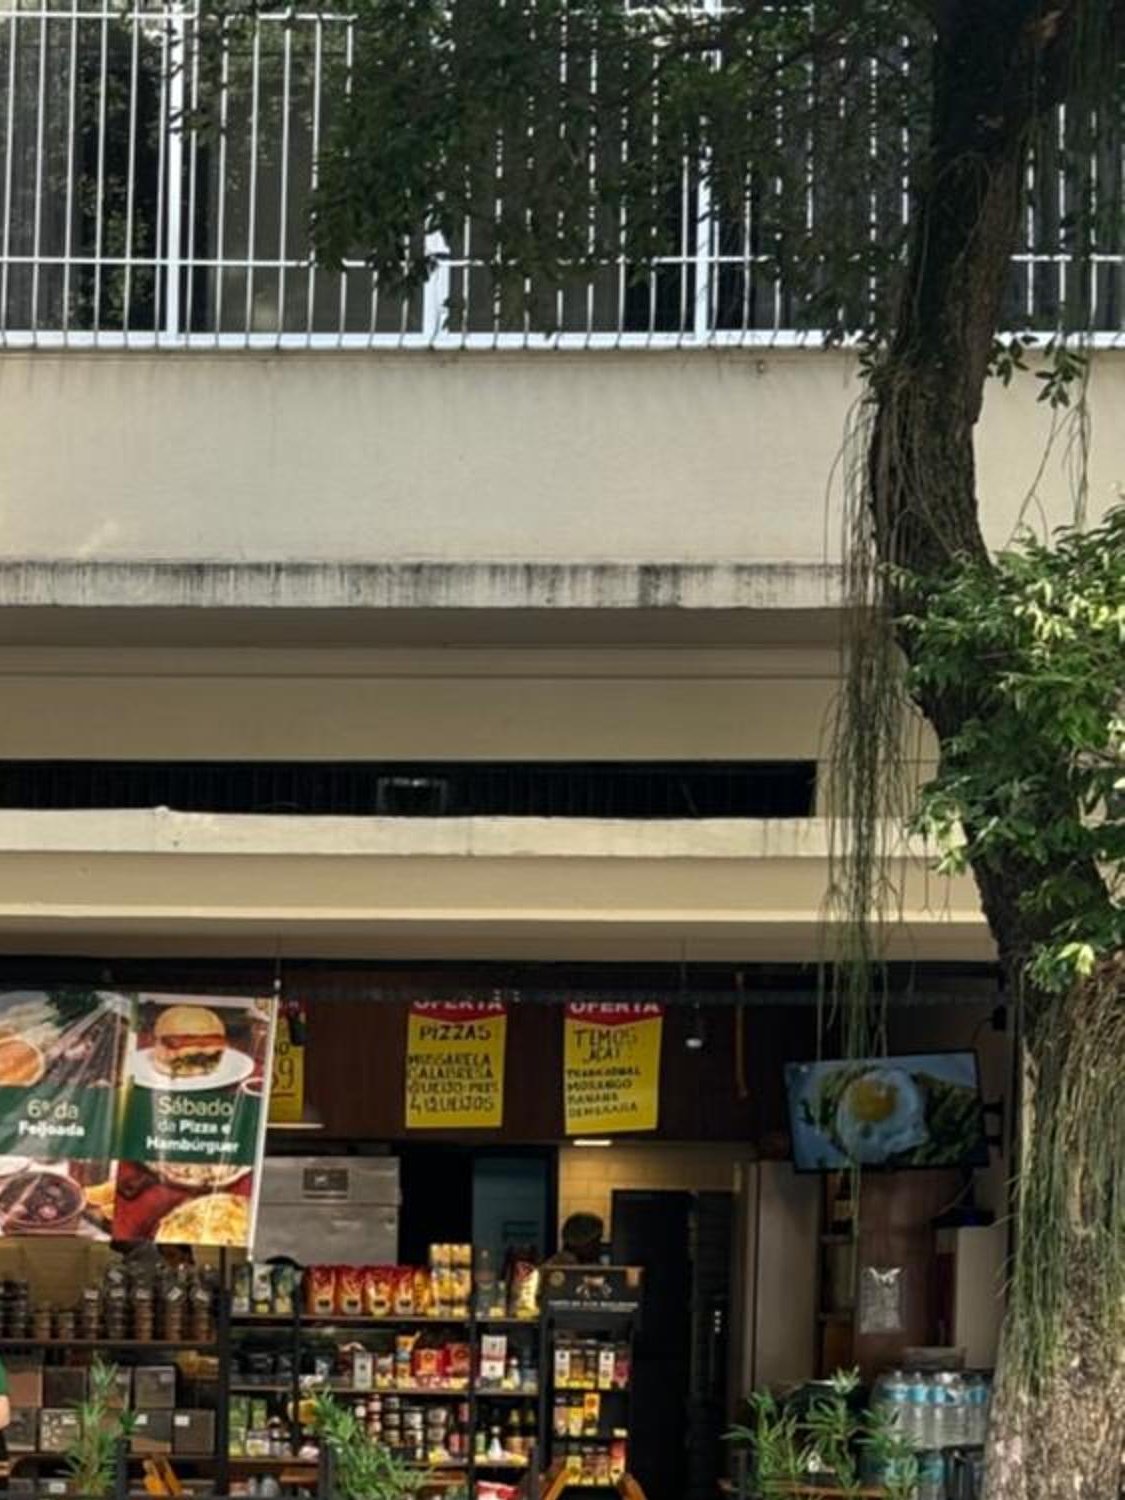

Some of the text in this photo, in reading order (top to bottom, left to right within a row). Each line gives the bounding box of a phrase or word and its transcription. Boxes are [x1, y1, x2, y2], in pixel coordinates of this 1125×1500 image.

[419, 1023, 492, 1041] PIZZAS
[53, 1101, 81, 1120] da
[158, 1096, 234, 1117] Sábado
[18, 1120, 86, 1137] Feijoada
[179, 1119, 219, 1134] Pizza
[221, 1123, 233, 1135] e
